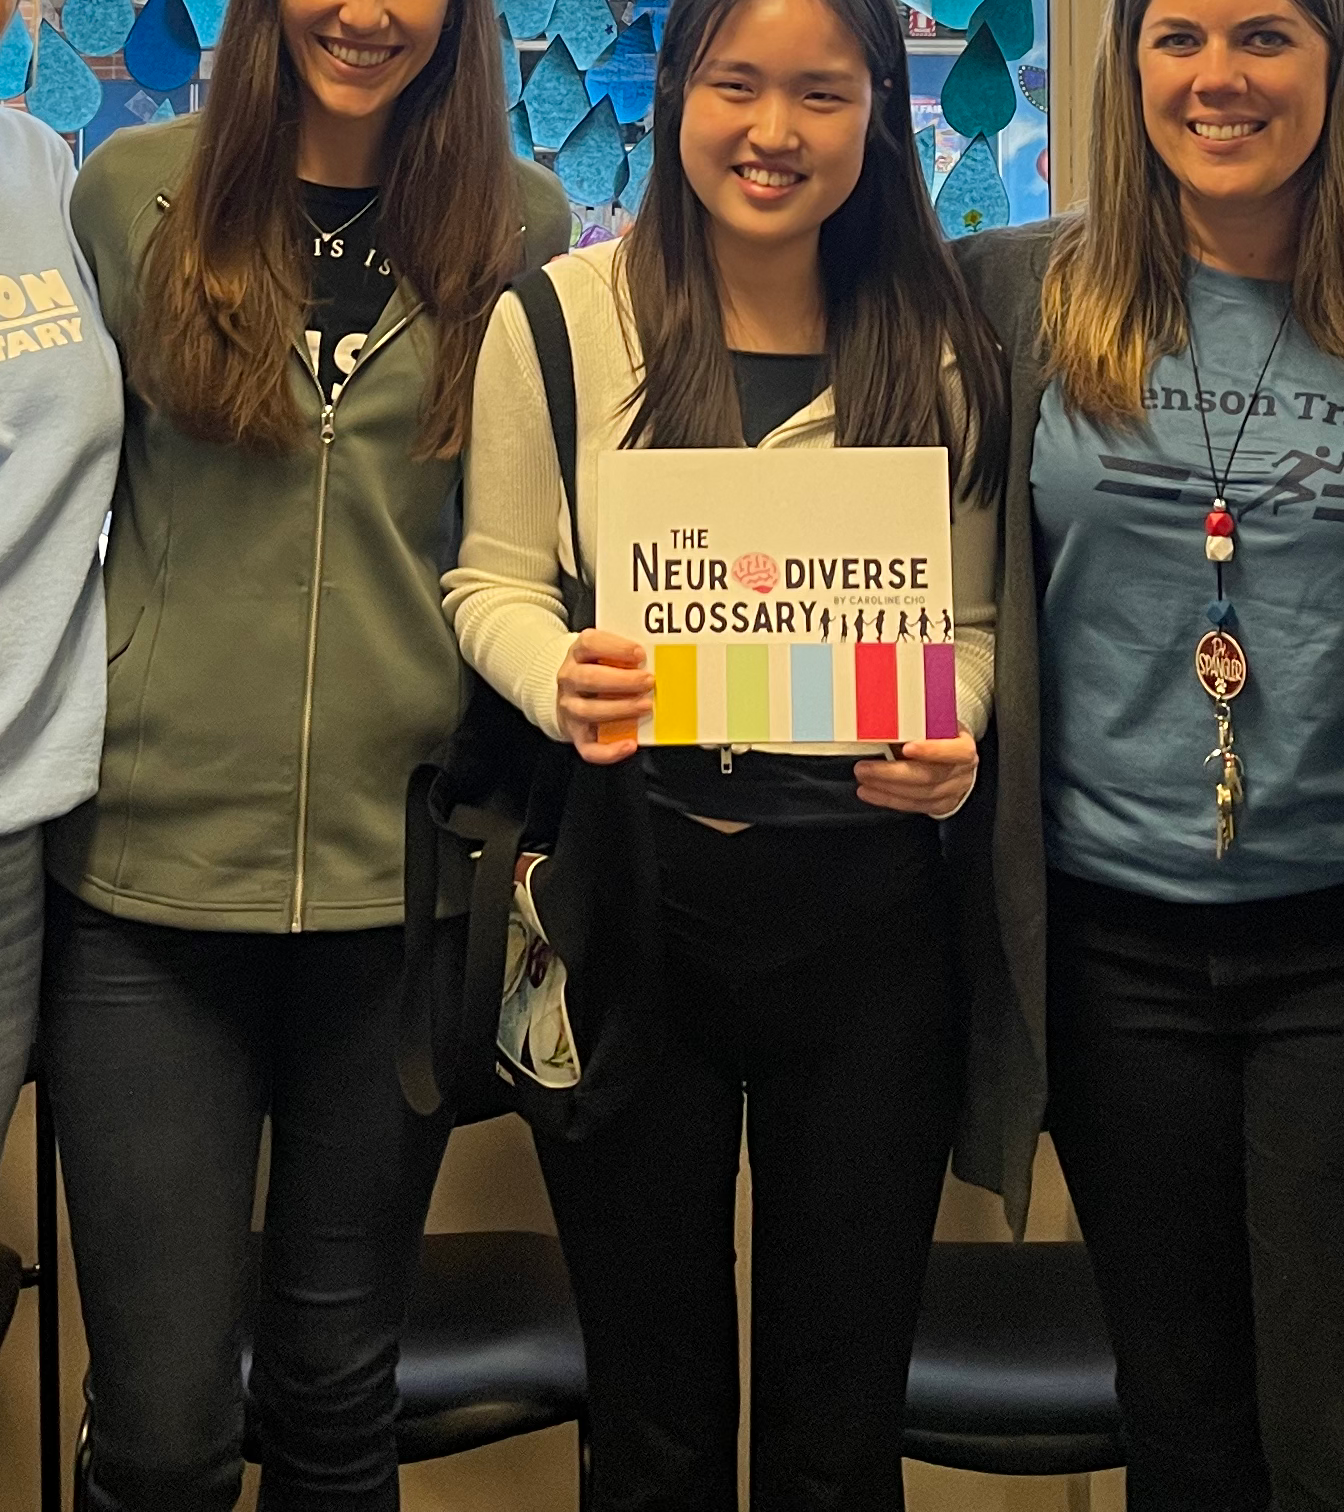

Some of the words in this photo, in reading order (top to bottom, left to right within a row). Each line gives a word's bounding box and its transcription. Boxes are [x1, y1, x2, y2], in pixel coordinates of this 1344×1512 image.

[313, 238, 345, 258] IS
[1141, 386, 1277, 417] enson
[669, 528, 709, 549] THE
[833, 595, 846, 605] BY
[849, 595, 901, 605] CAROLINE
[904, 595, 926, 605] CHO
[643, 600, 818, 634] GLOSSARY
